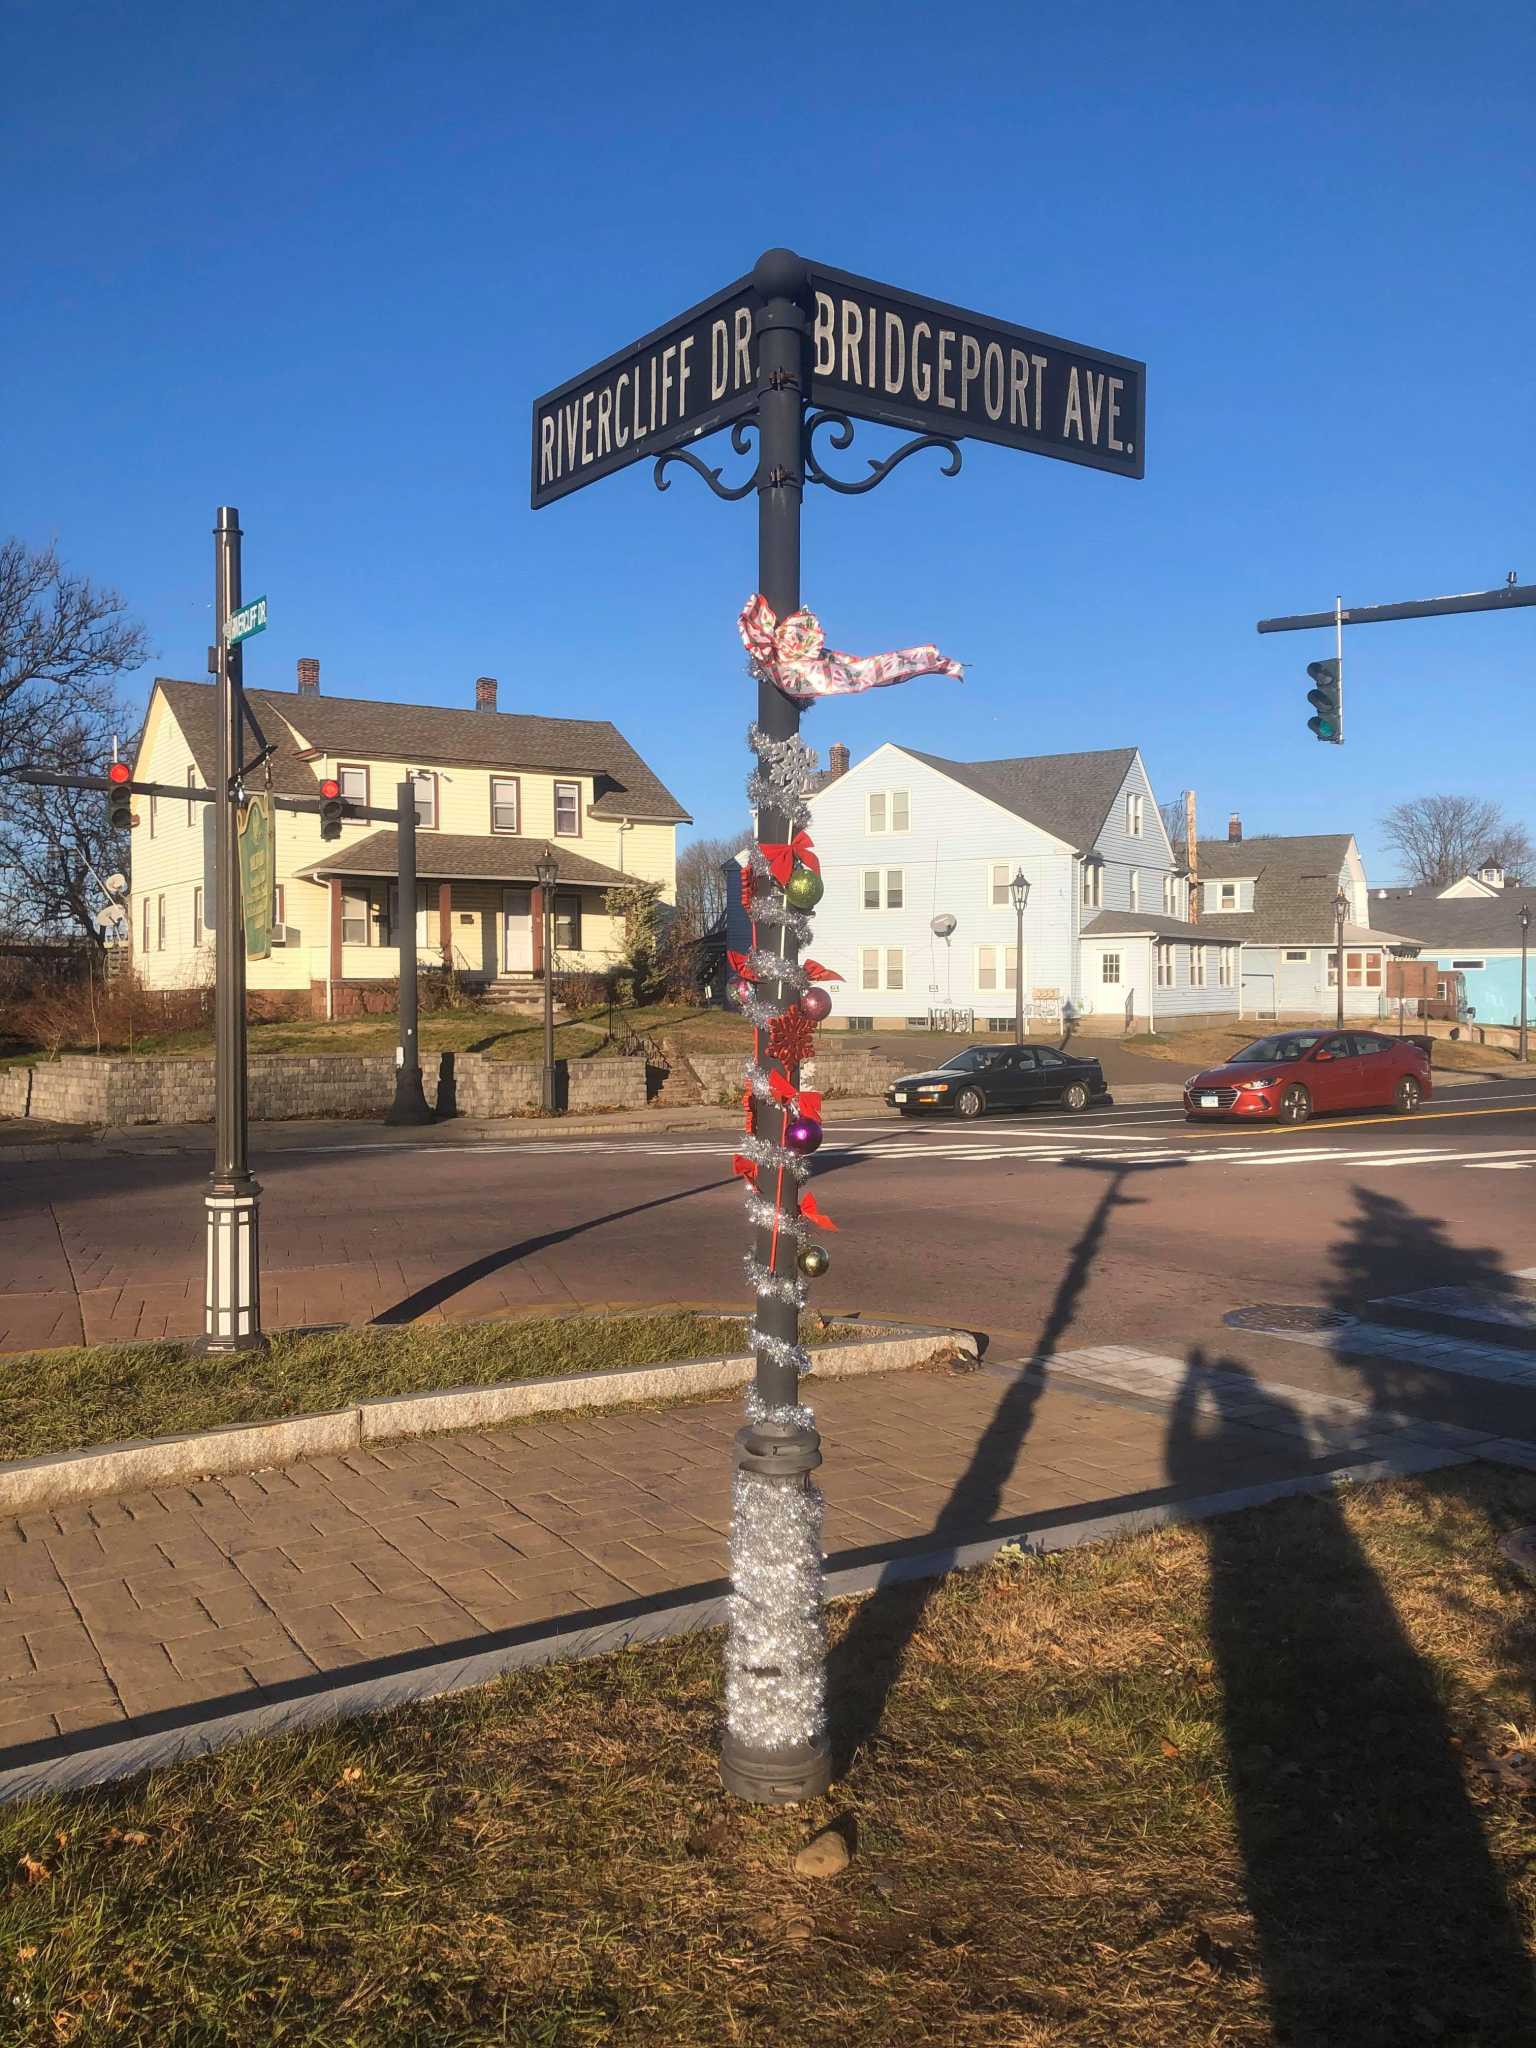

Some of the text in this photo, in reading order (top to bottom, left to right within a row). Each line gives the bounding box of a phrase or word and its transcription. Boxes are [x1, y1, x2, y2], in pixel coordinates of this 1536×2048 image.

[541, 335, 695, 485] RIVERCLIFF
[814, 291, 1134, 454] BRIDGEPORT AVE.
